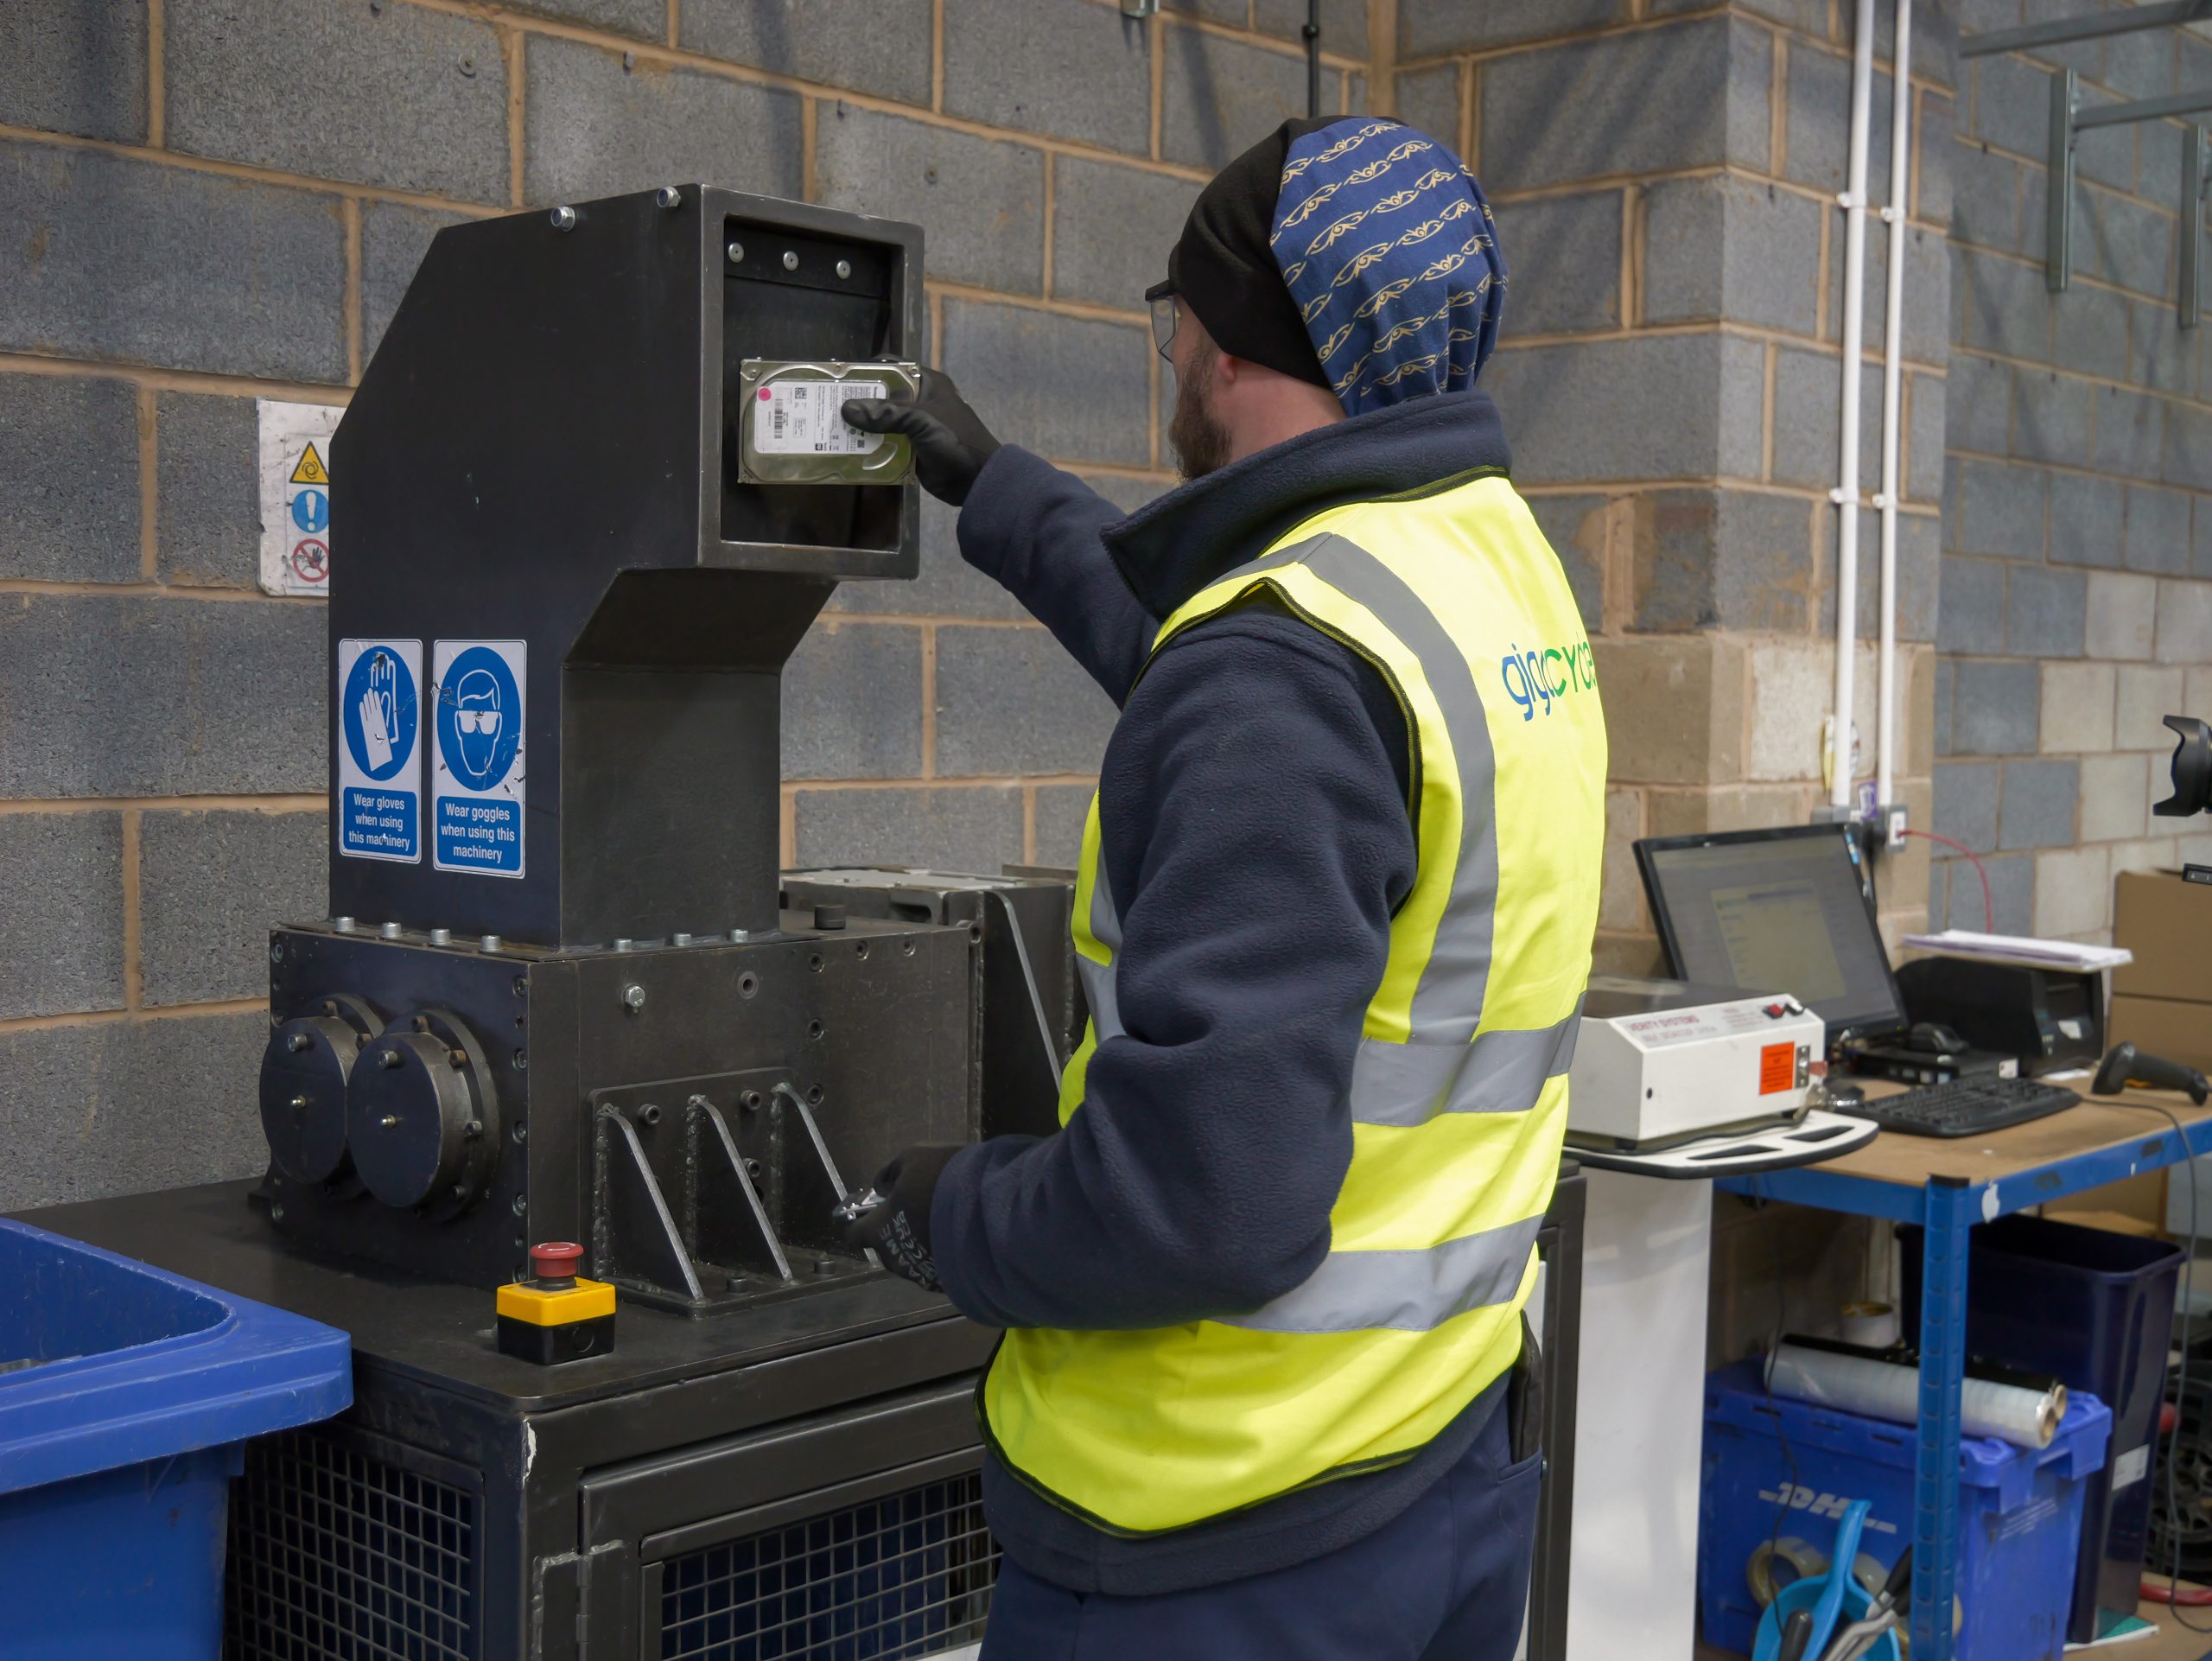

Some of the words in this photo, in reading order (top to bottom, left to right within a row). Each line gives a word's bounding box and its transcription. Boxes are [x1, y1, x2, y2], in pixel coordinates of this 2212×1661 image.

[353, 793, 375, 807] Wear
[377, 796, 405, 811] gloves
[355, 813, 378, 826] when
[379, 815, 404, 832] using
[445, 803, 469, 818] Wear
[472, 806, 510, 823] goggles
[348, 830, 364, 843] this
[366, 832, 410, 852] machinery
[441, 823, 466, 837] when
[468, 825, 494, 843] using
[497, 827, 515, 842] this
[453, 845, 503, 864] machinery
